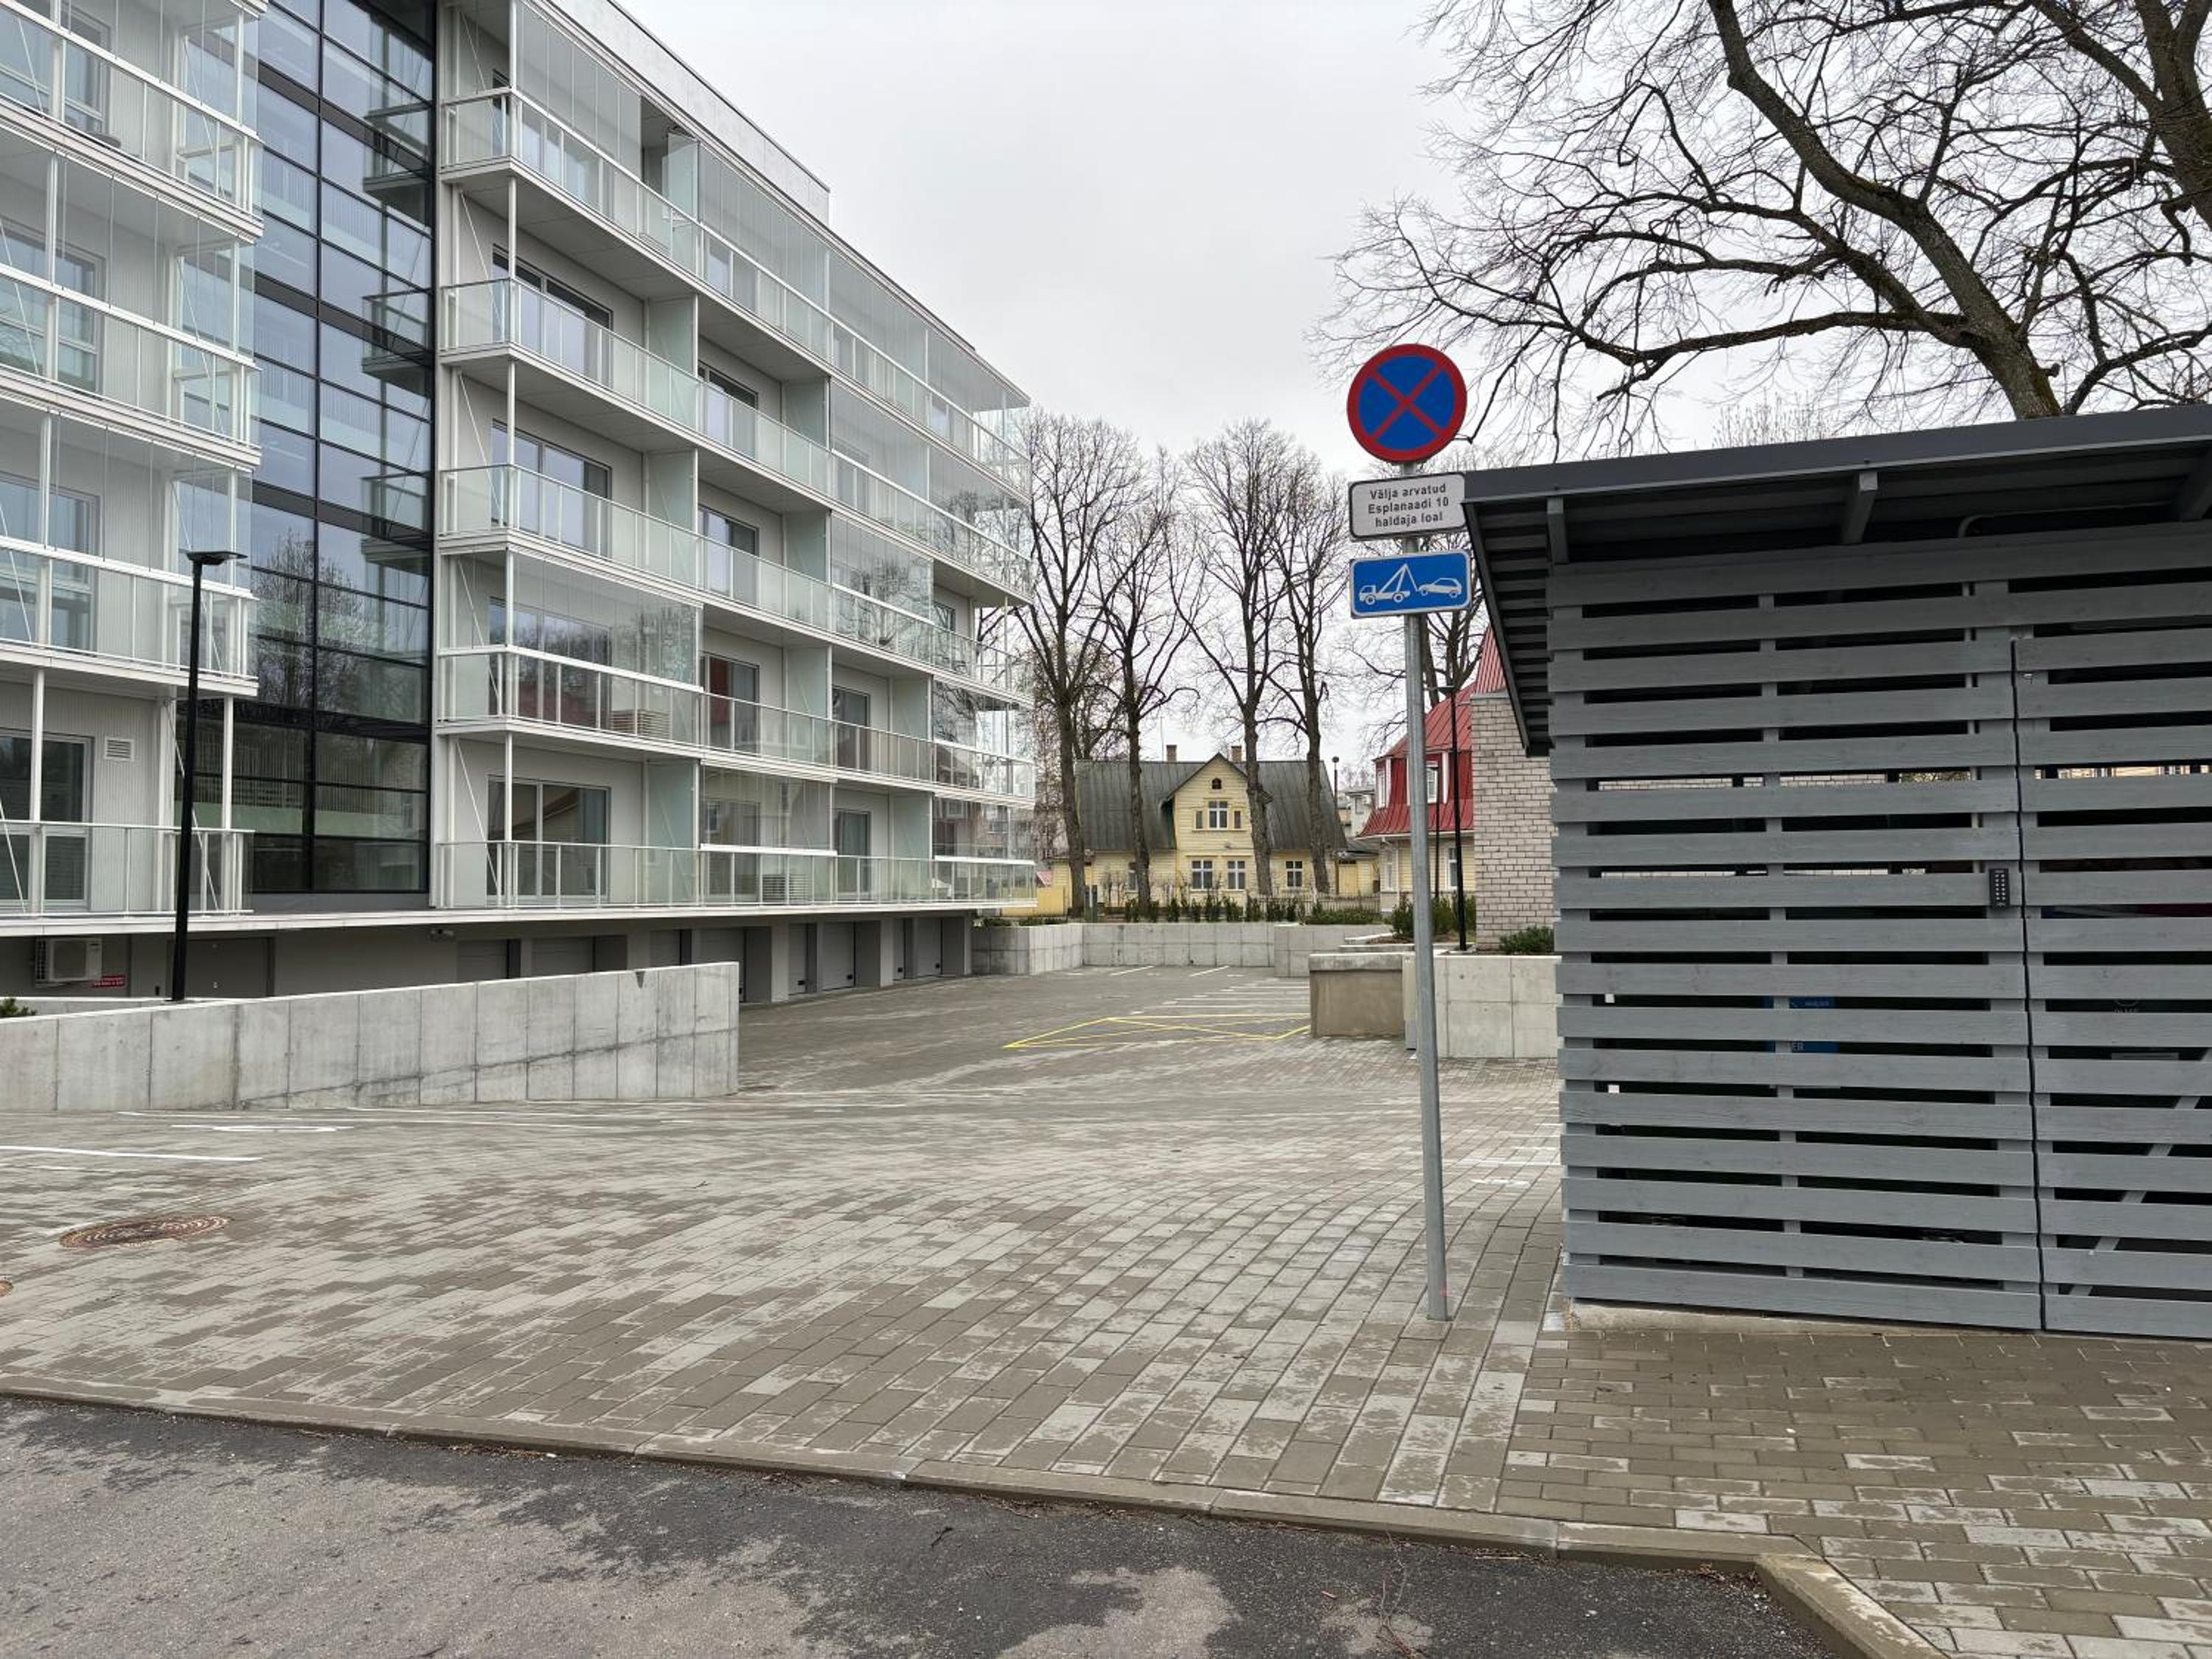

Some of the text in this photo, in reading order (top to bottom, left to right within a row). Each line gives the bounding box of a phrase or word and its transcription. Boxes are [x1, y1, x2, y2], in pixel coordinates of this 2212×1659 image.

[1370, 484, 1446, 500] Välja arvatud
[1368, 497, 1449, 515] Esplanaadi 10
[1375, 516, 1416, 527] haldaja
